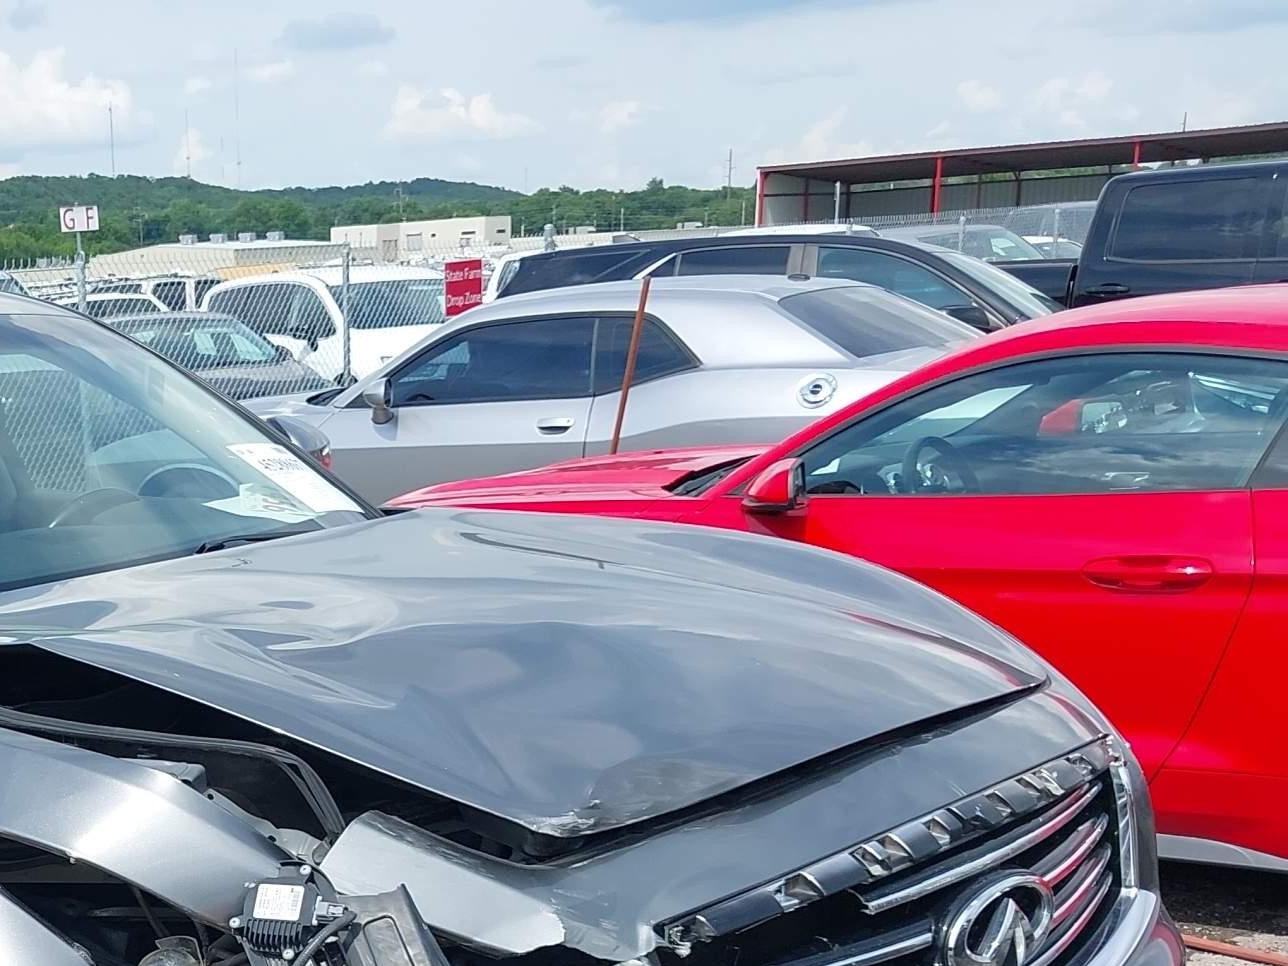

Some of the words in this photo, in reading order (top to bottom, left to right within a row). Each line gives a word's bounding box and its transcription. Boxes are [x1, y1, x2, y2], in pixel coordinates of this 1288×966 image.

[63, 208, 75, 230] G
[86, 207, 94, 229] F
[446, 270, 464, 281] State
[464, 267, 481, 280] Farm
[446, 294, 464, 308] Drop
[464, 291, 481, 304] Zone
